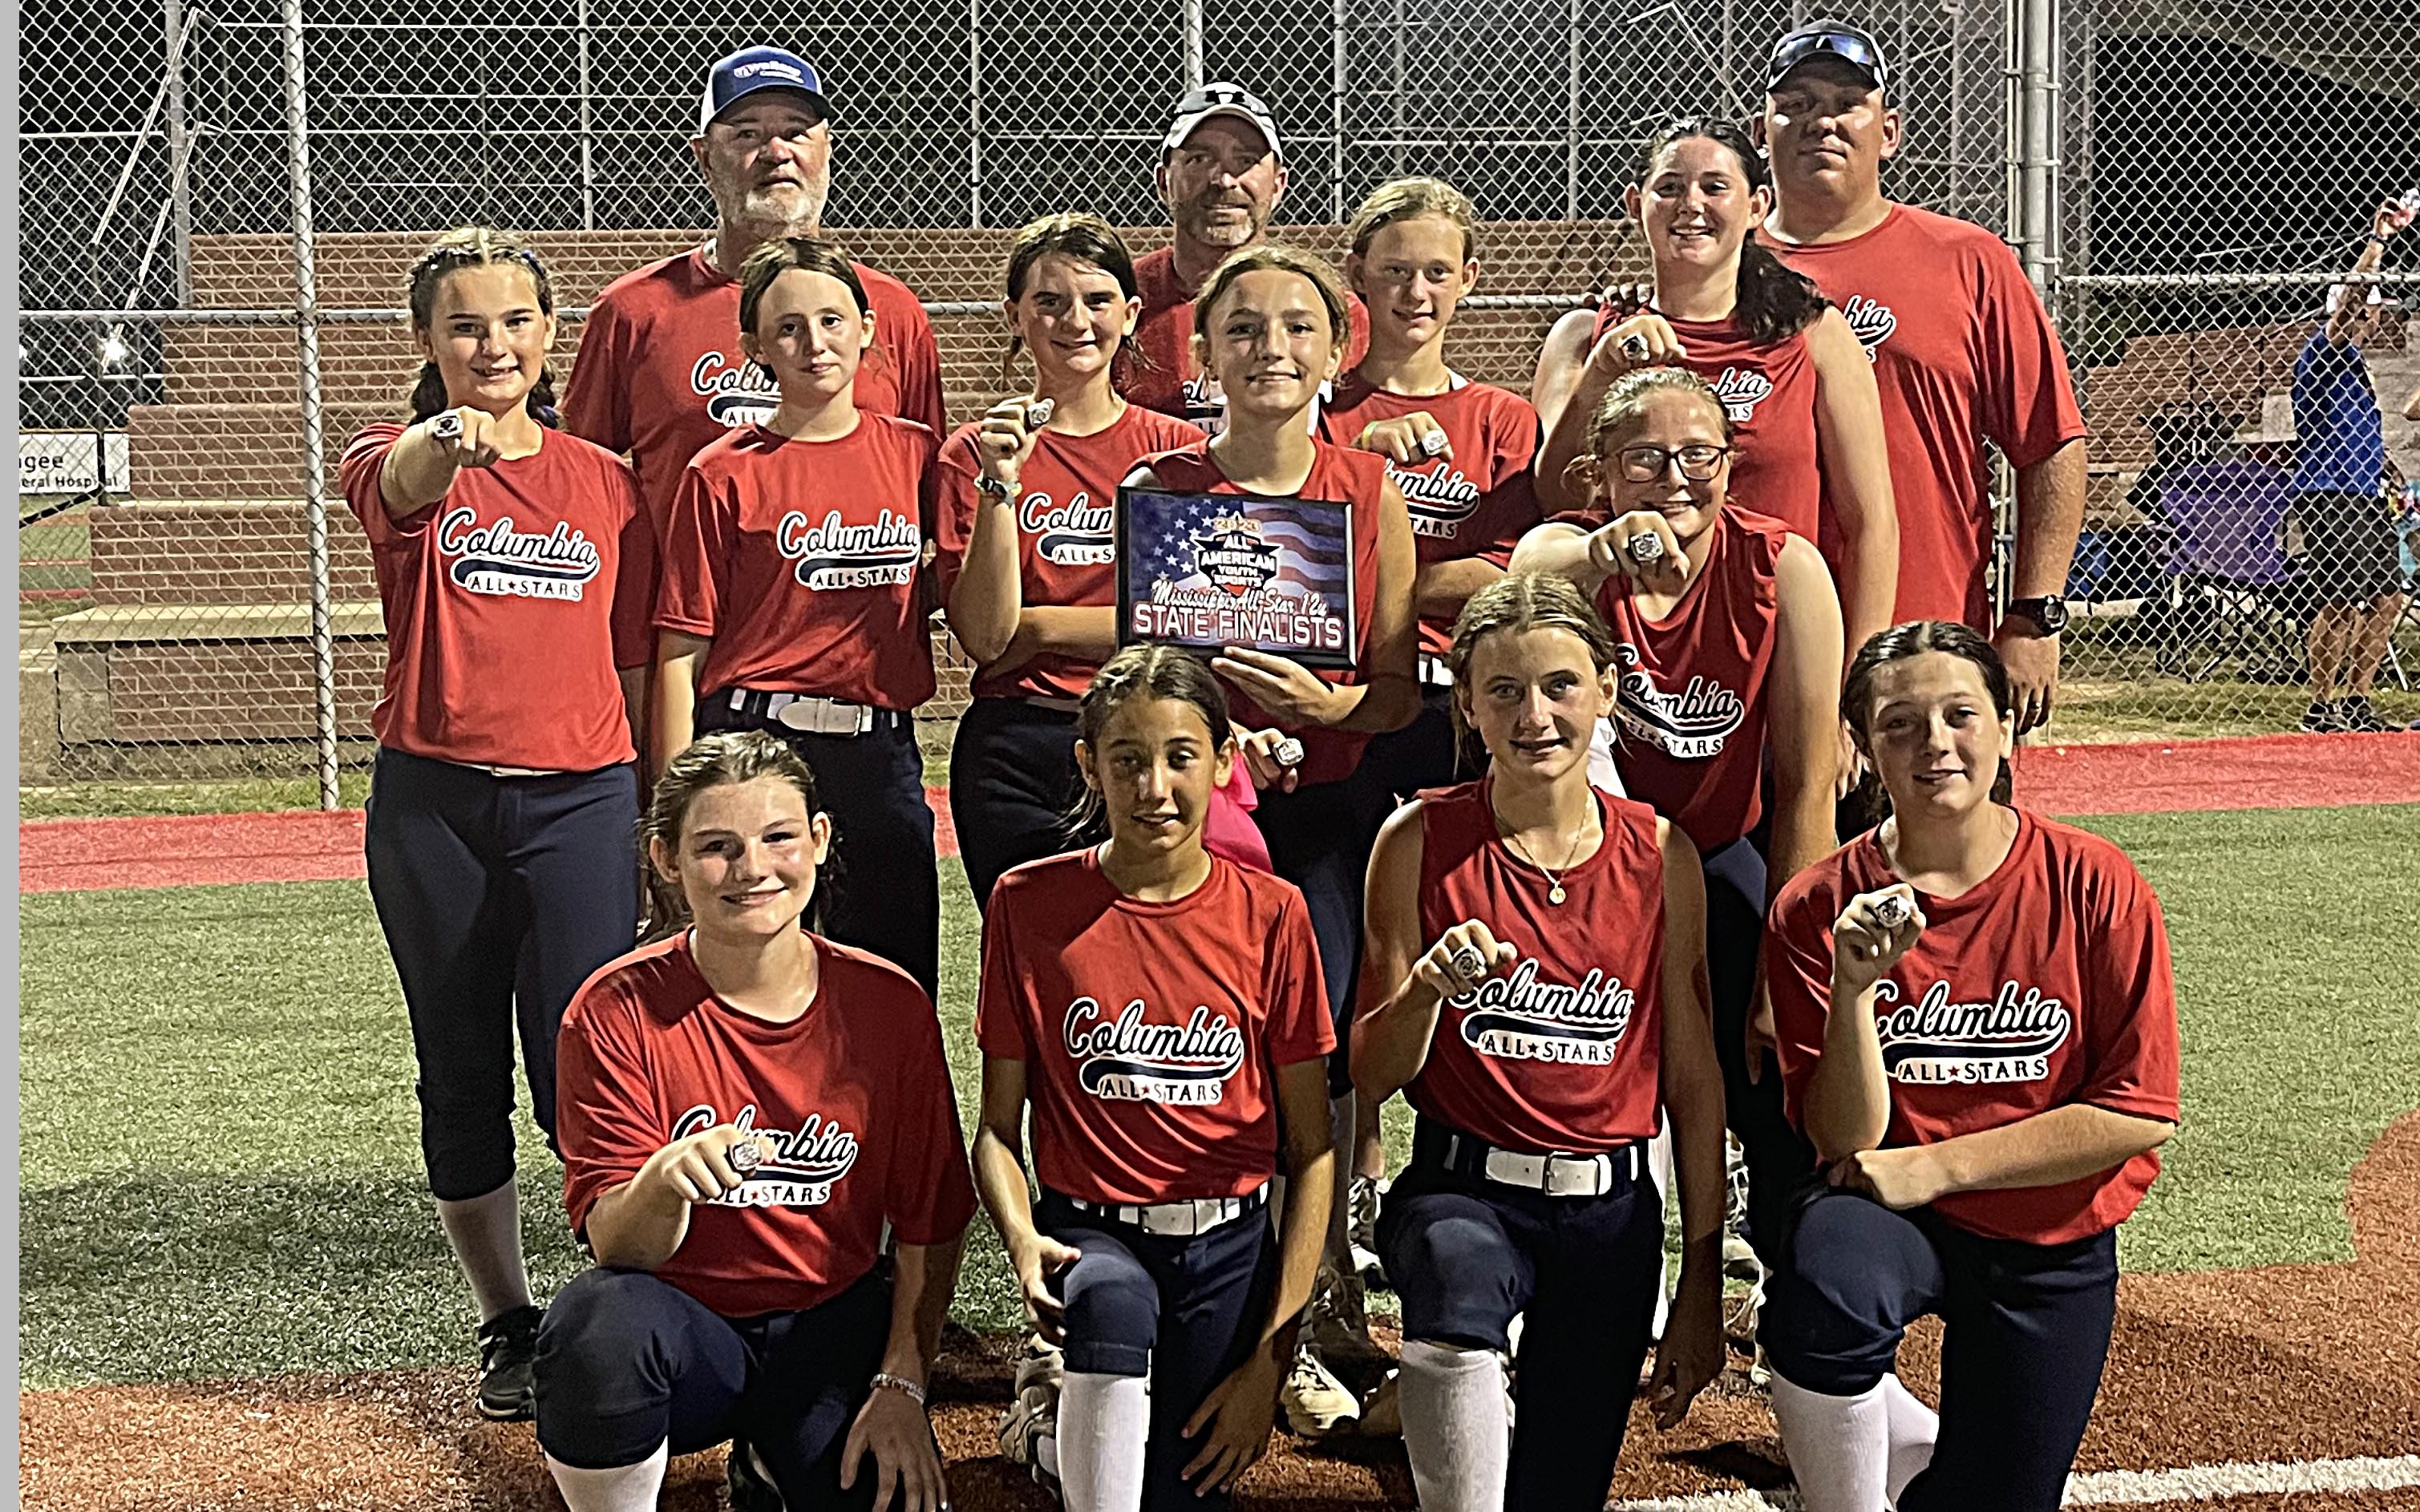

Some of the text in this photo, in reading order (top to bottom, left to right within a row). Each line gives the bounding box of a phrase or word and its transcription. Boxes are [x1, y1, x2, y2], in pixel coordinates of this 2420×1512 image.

[694, 354, 775, 393] Colu
[1022, 494, 1113, 531] Colum
[779, 511, 920, 555] Columbia
[1213, 517, 1261, 532] 2023
[1410, 517, 1455, 538] TARS
[439, 508, 600, 565] Columbia
[1223, 534, 1252, 551] ALL
[1200, 551, 1277, 572] AMERICAN
[1217, 565, 1259, 577] YOUTH
[470, 576, 581, 599] ALL STARS
[815, 572, 846, 587] ALL
[1134, 604, 1342, 648] STATE FINALISTS
[1065, 1000, 1241, 1058] Columbia
[1483, 1034, 1613, 1062] ALL STARS
[1902, 1059, 2046, 1081] ALL STARS
[1103, 1078, 1220, 1102] ALL STARS
[762, 1186, 828, 1203] STARS
